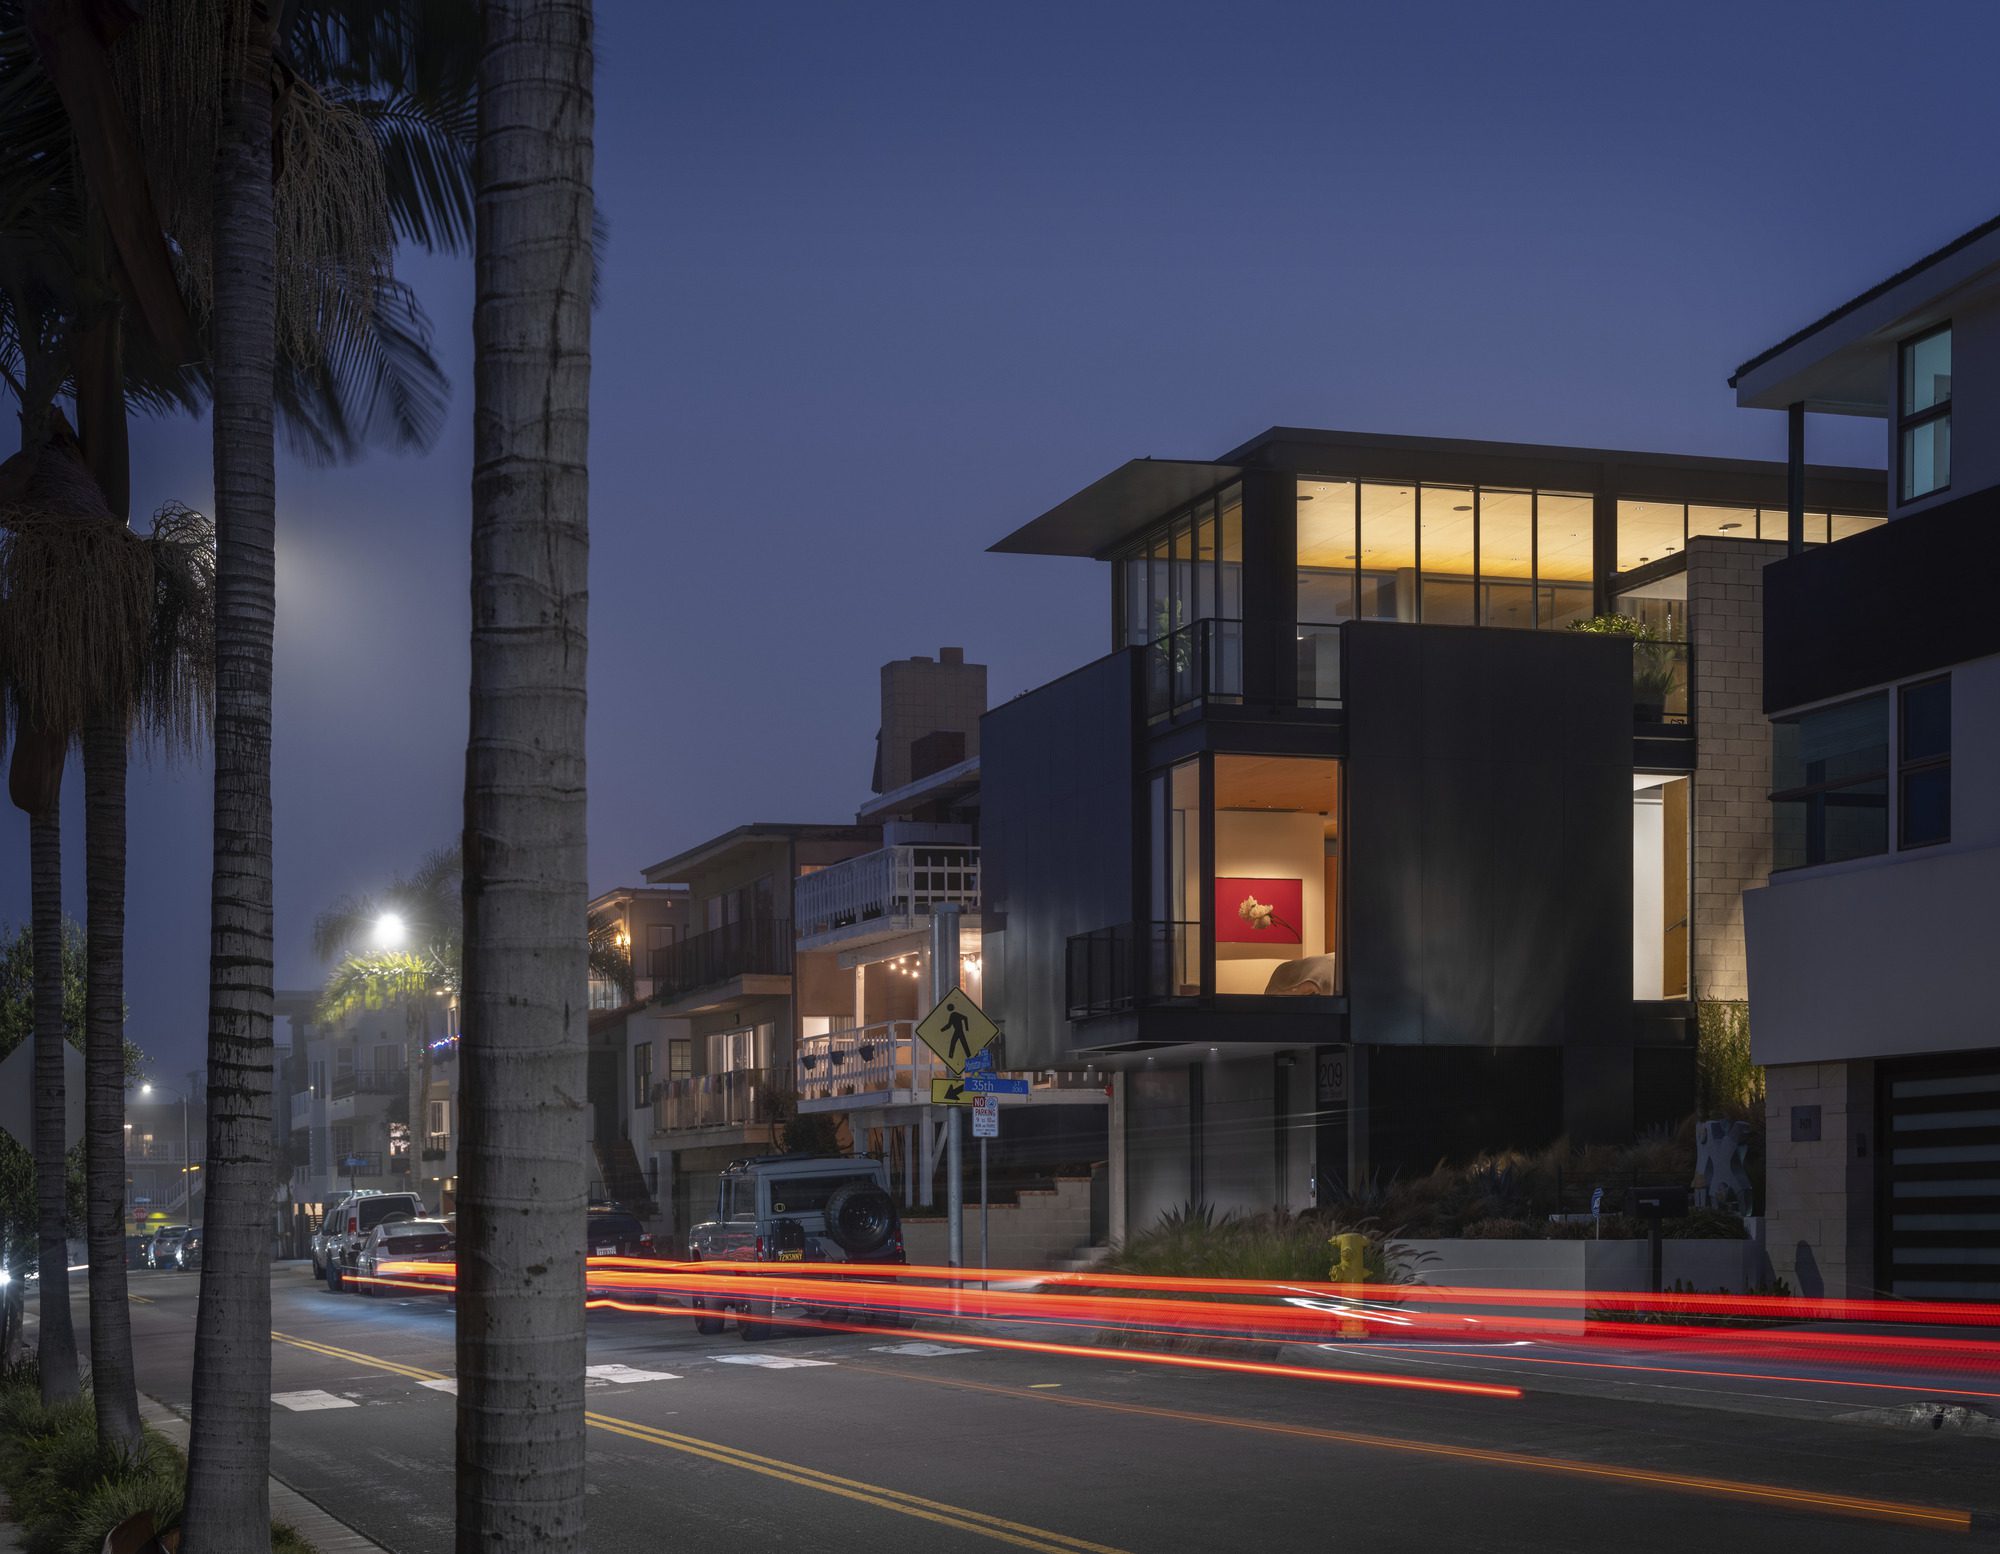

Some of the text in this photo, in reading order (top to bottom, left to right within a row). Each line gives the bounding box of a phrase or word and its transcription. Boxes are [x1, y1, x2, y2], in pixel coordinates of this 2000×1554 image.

[1319, 1062, 1343, 1088] 209
[972, 1079, 994, 1092] 35th
[974, 1097, 985, 1107] NO
[975, 1108, 996, 1117] PARKING
